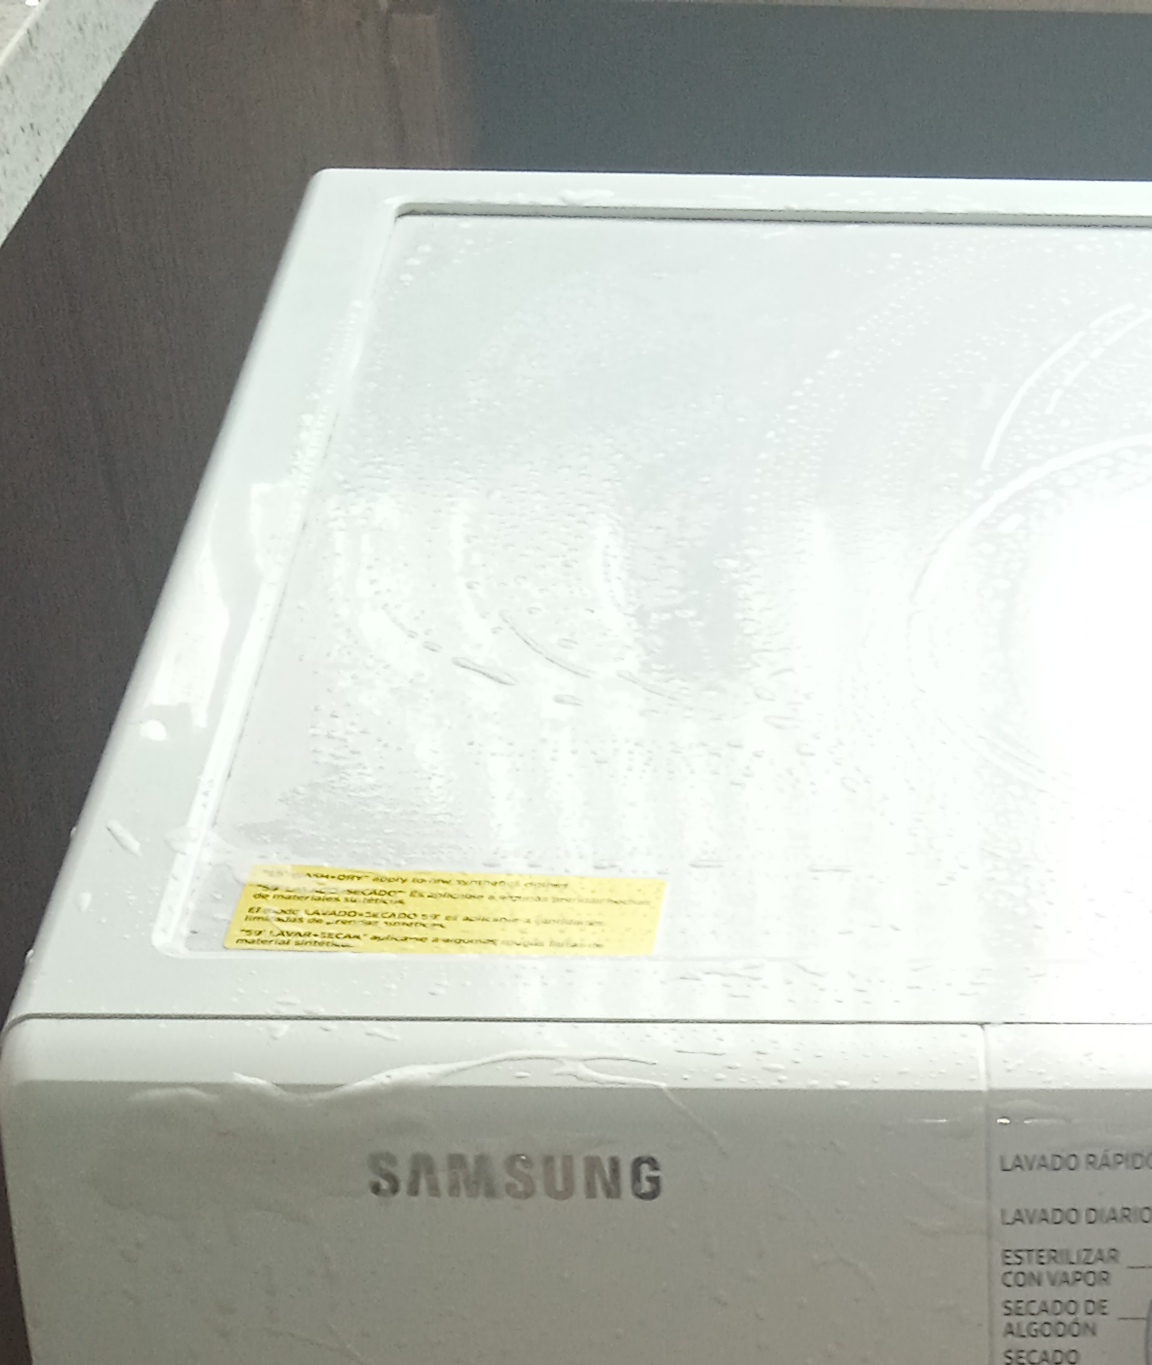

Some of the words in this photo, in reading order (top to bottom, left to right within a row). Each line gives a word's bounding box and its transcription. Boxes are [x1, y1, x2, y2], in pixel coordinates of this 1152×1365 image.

[1000, 1153, 1079, 1172] LAVADO
[367, 1151, 662, 1201] SAMSUNG
[1000, 1207, 1079, 1225] LAVADO
[1002, 1248, 1121, 1266] ESTERILIZAR
[1001, 1270, 1042, 1288] CON
[1046, 1270, 1112, 1287] VAPOR
[1002, 1299, 1080, 1316] SECADO
[1084, 1299, 1109, 1316] DE
[1003, 1317, 1097, 1338] ALGODÓN
[1003, 1349, 1080, 1365] SECADO
